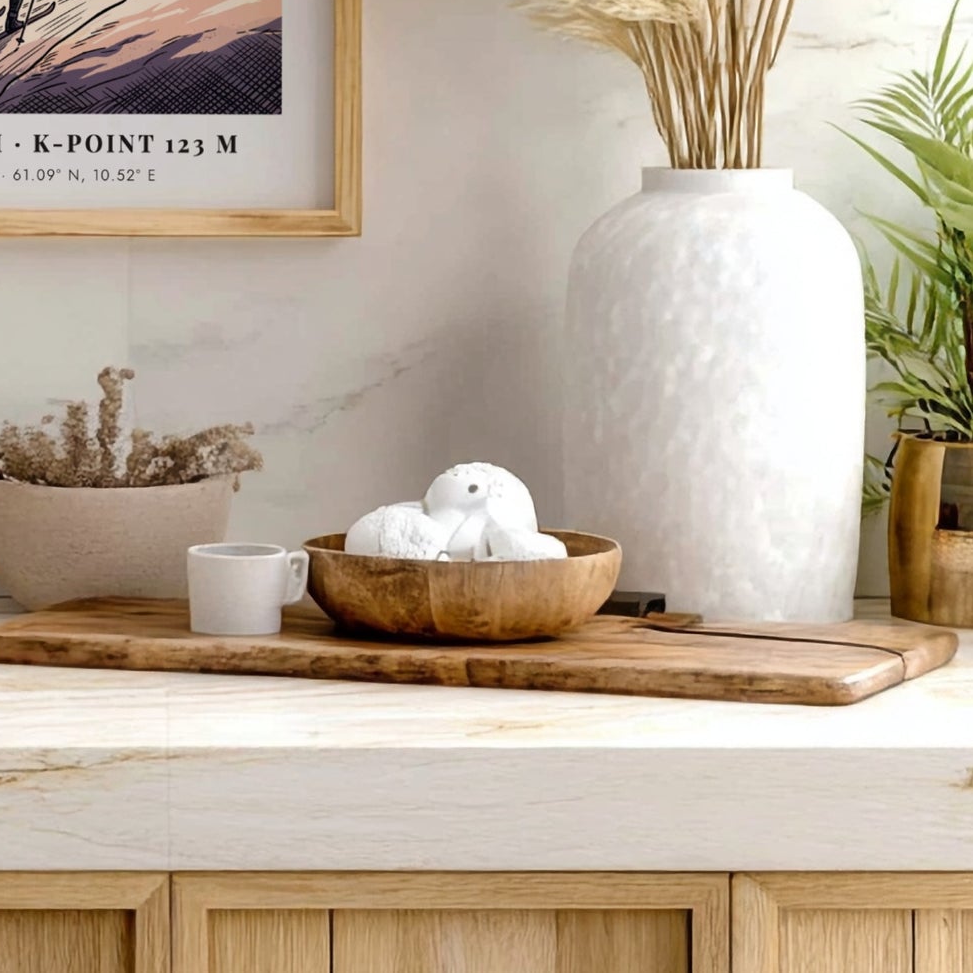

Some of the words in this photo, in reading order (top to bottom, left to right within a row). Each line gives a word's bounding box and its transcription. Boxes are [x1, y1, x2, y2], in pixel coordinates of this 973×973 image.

[32, 133, 155, 154] K-POINT
[165, 137, 205, 158] 123
[215, 134, 239, 154] M
[12, 168, 61, 182] 61.09°
[68, 168, 85, 184] N,
[93, 168, 141, 182] 10.52°
[147, 168, 156, 182] E
